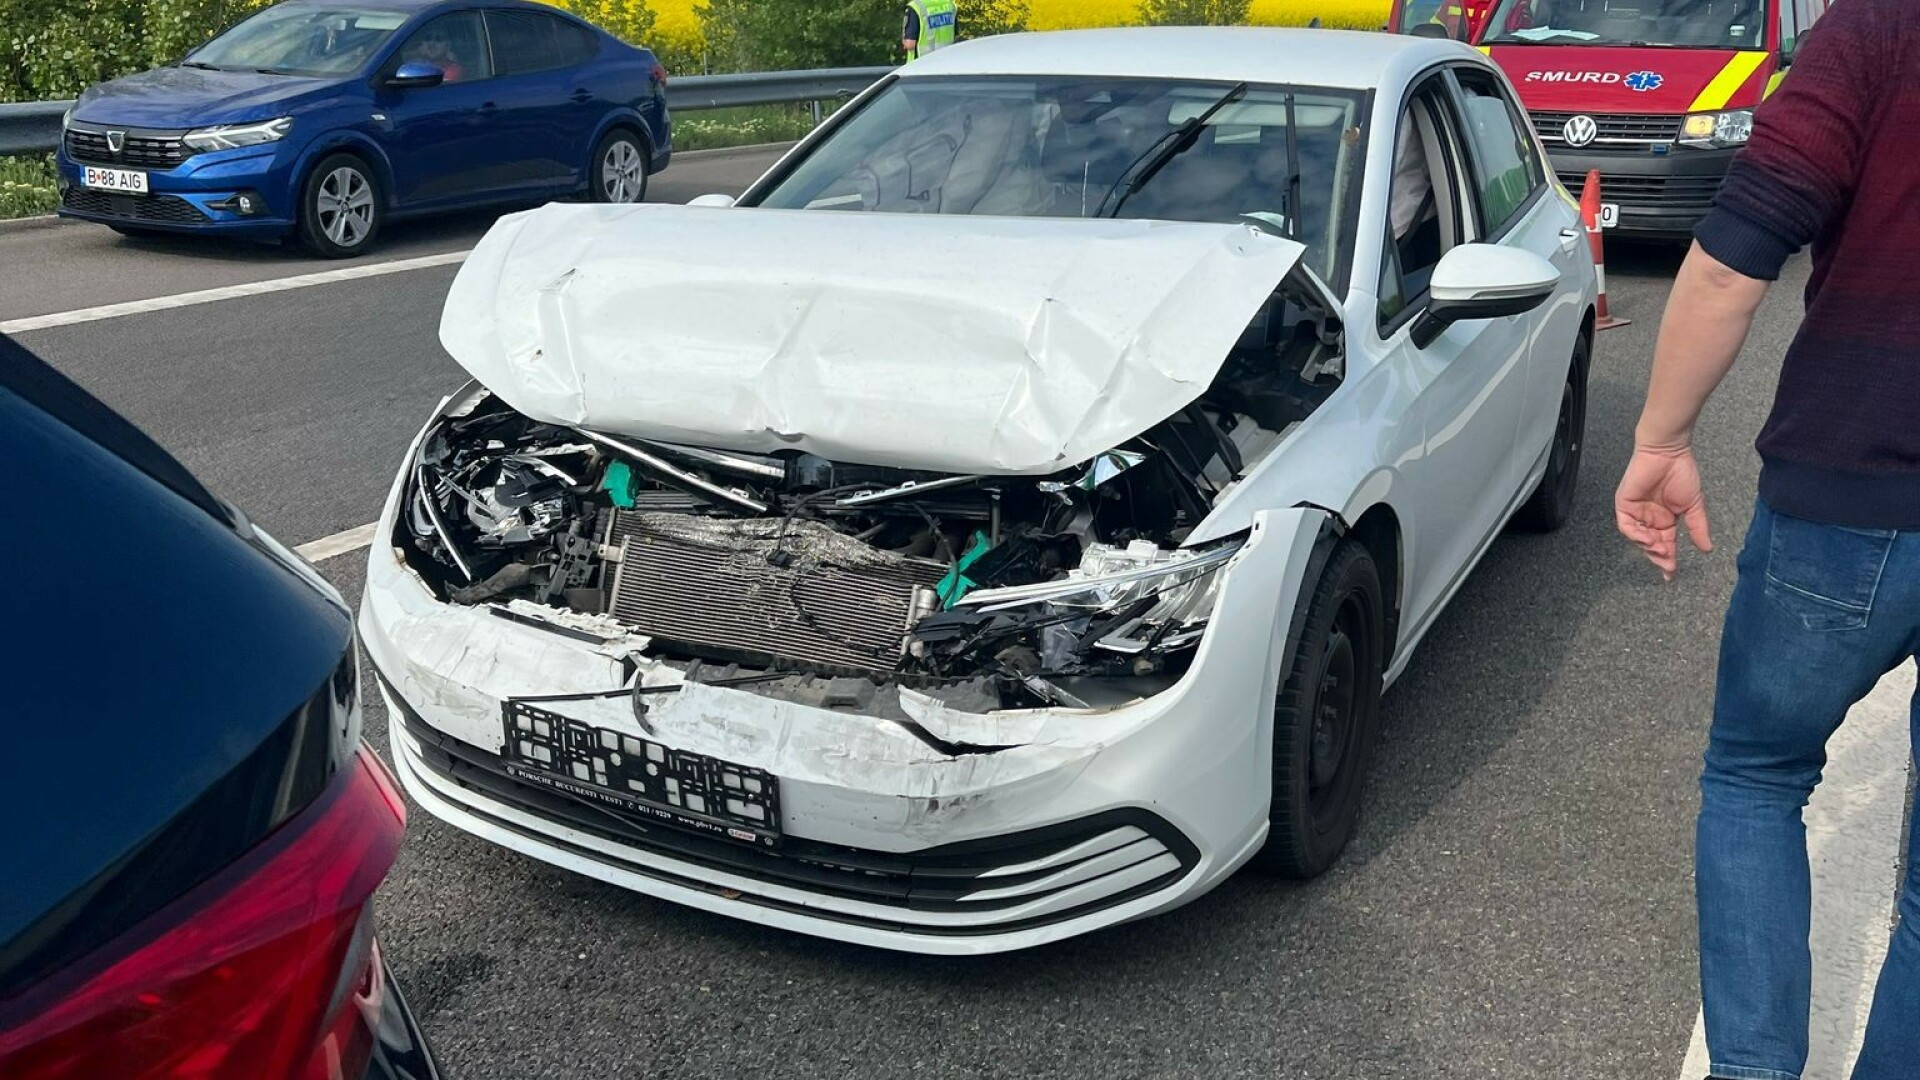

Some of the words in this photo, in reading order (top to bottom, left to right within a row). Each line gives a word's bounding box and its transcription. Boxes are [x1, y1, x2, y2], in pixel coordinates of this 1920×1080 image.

[1525, 71, 1620, 83] SMURD
[88, 169, 96, 184] B
[101, 170, 115, 186] 88
[120, 173, 141, 189] AIG
